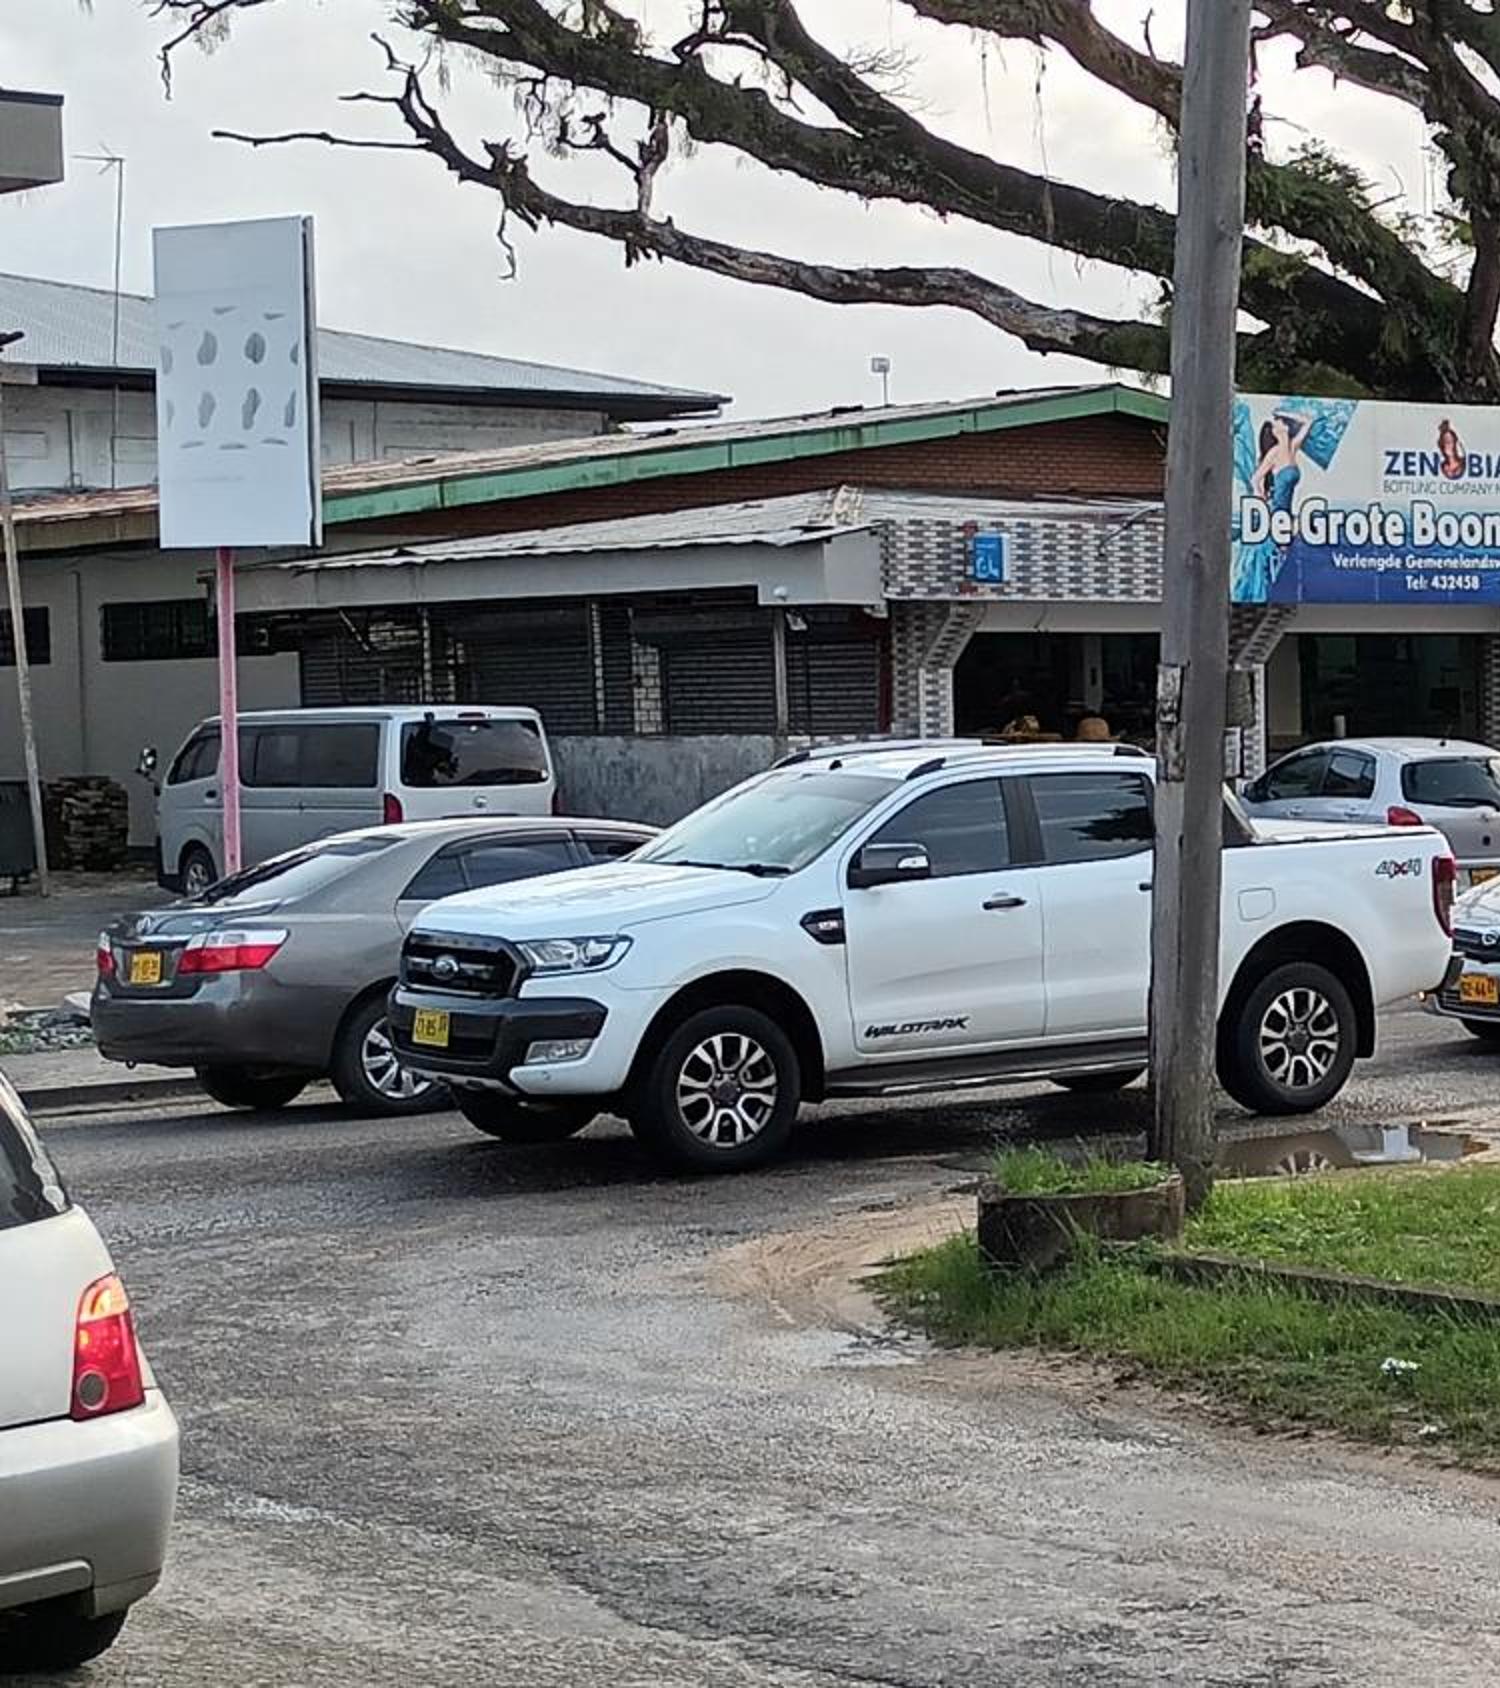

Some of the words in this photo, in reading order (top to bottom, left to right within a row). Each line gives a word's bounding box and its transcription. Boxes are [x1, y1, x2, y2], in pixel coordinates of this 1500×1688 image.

[1439, 481, 1494, 496] COMPANY
[1240, 496, 1292, 549] De
[1298, 496, 1406, 549] Grote
[1331, 552, 1402, 571] Verlengde
[1431, 575, 1481, 591] 432458
[864, 1016, 970, 1038] WILDTRAK
